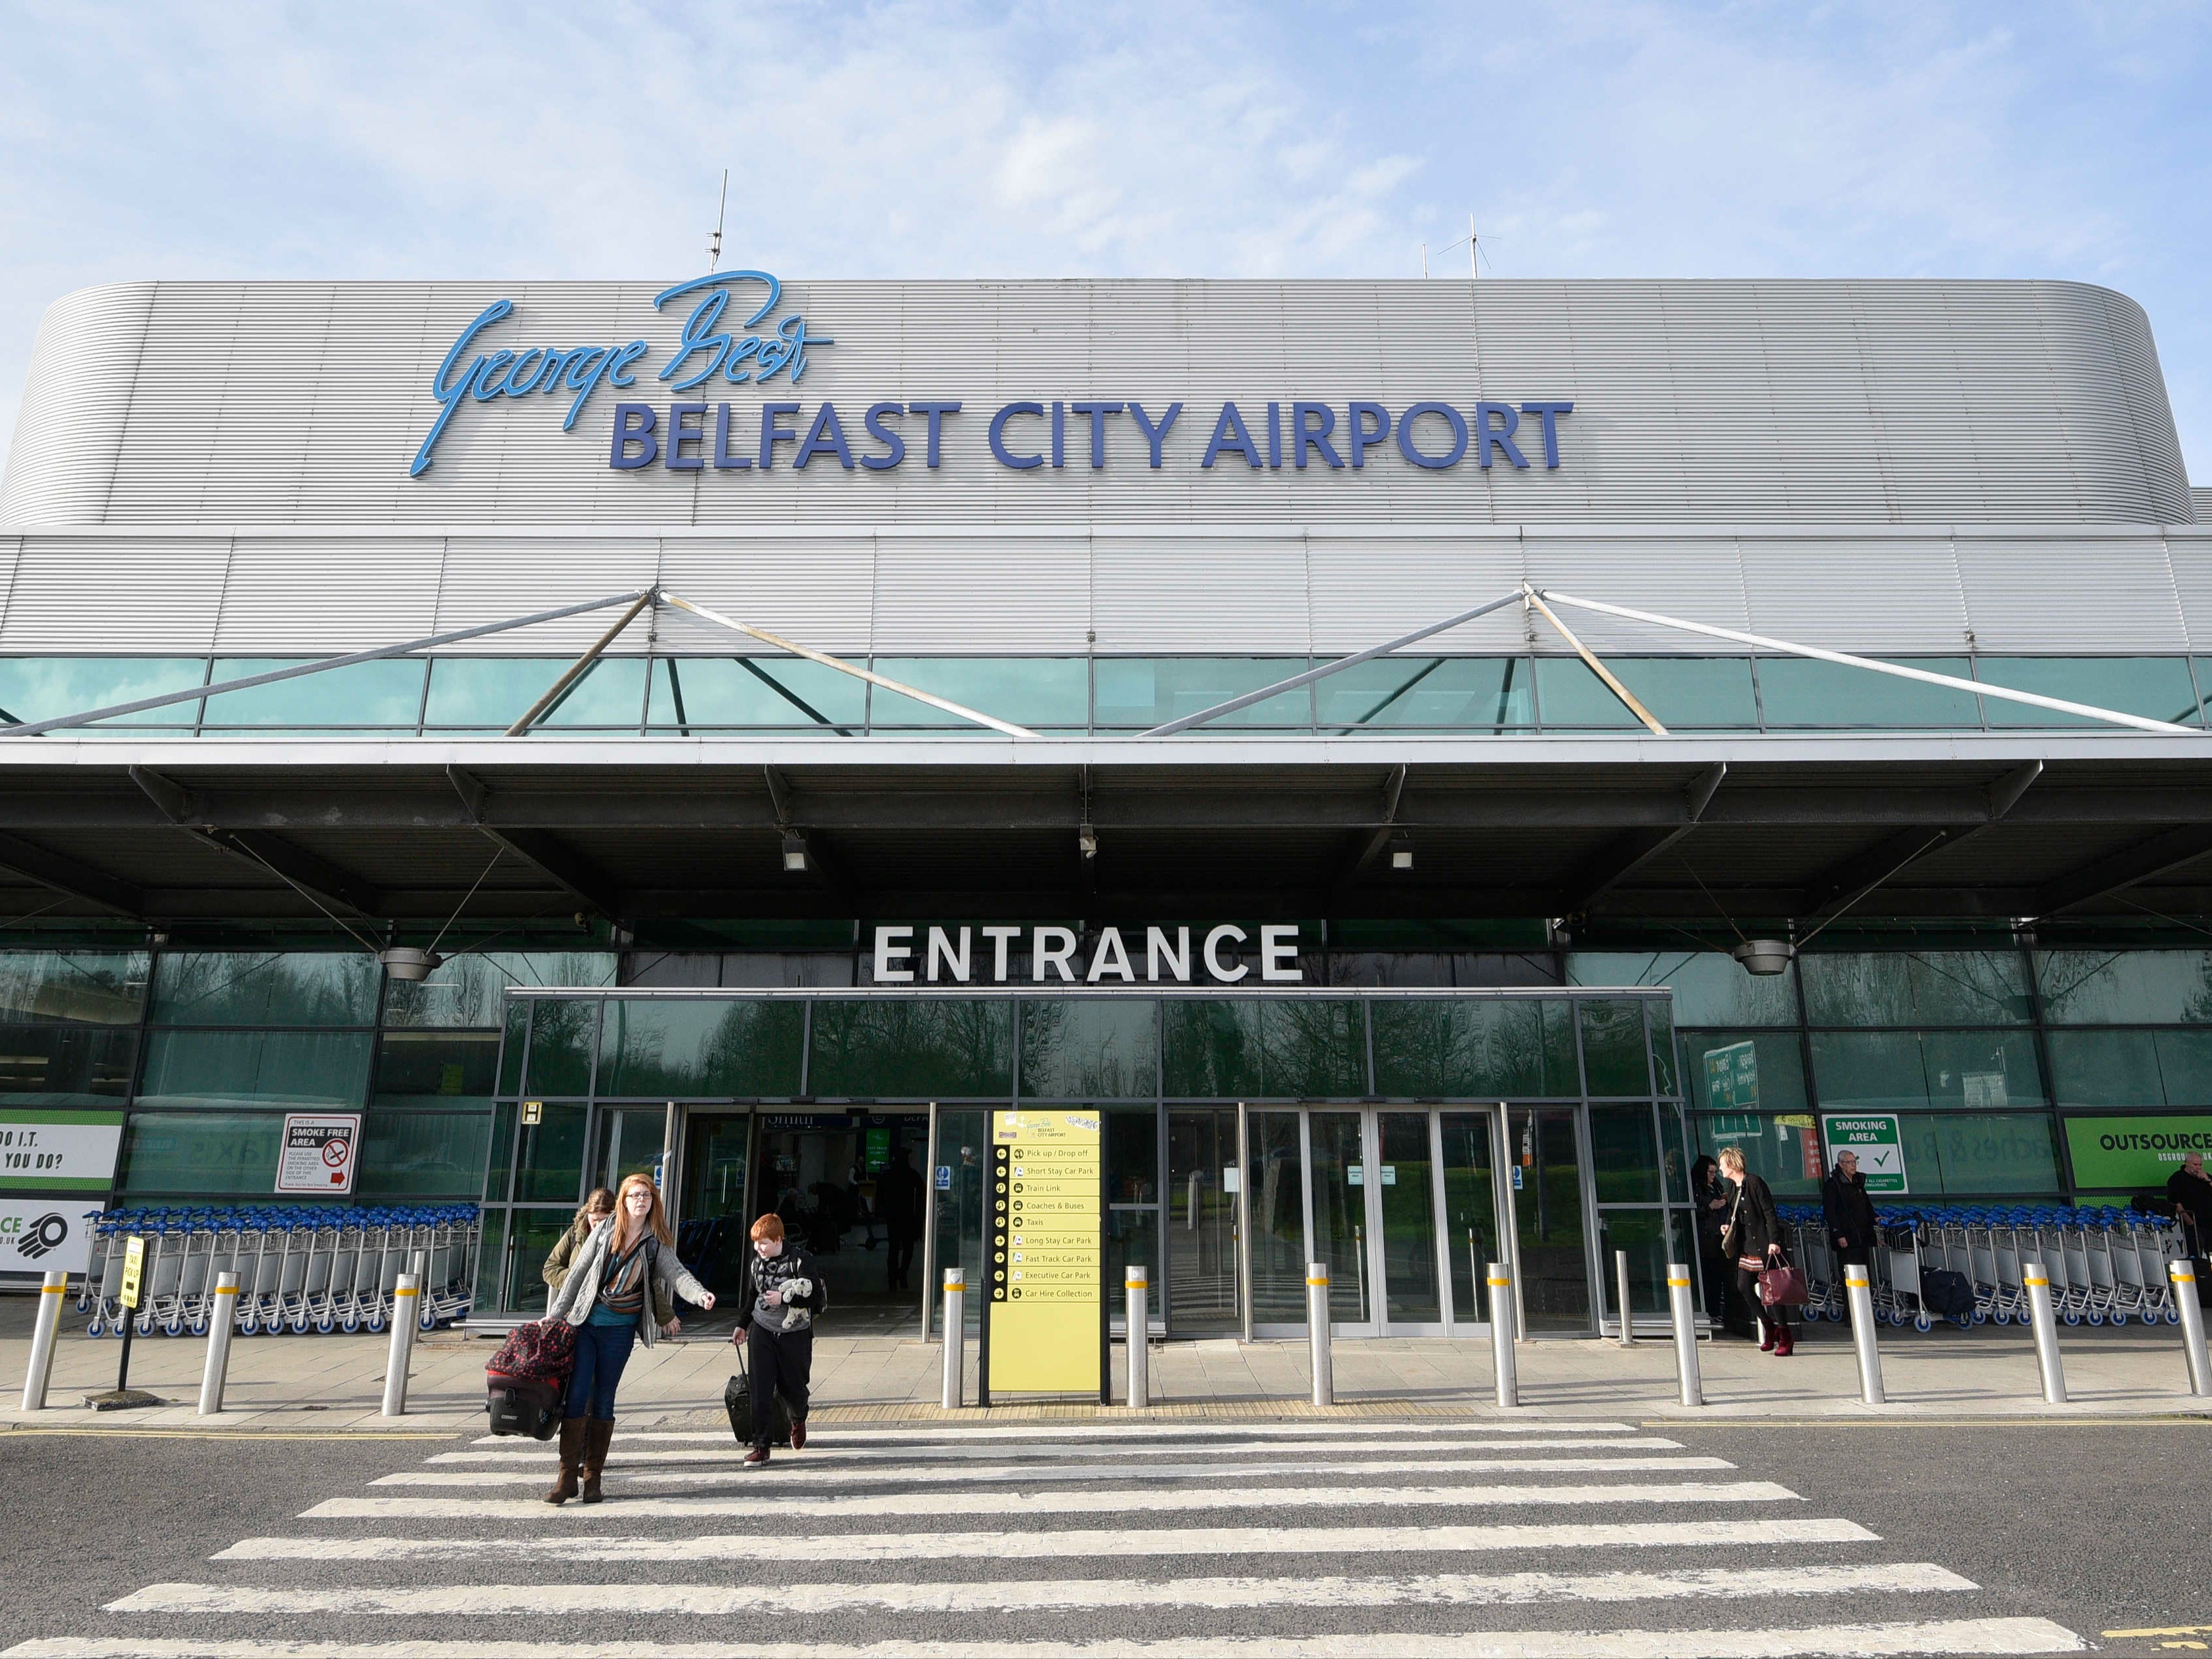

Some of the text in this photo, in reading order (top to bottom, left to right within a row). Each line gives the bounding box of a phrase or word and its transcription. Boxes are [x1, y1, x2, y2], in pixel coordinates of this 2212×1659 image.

[409, 269, 833, 478] George Best
[609, 401, 1574, 470] BELFAST CITY AIRPORT
[873, 925, 1303, 982] ENTRANCE
[1835, 1121, 1887, 1130] SMOKING
[292, 1128, 325, 1137] SMOKE
[1848, 1133, 1877, 1141] AREA
[18, 1131, 38, 1146] I.T.
[2100, 1133, 2212, 1150] OUTSOURCE
[1058, 1150, 1075, 1159] Drop
[5, 1153, 63, 1169] YOU DO?
[1048, 1167, 1062, 1176] Stay
[129, 1255, 138, 1265] TAXI
[133, 1269, 139, 1278] UP
